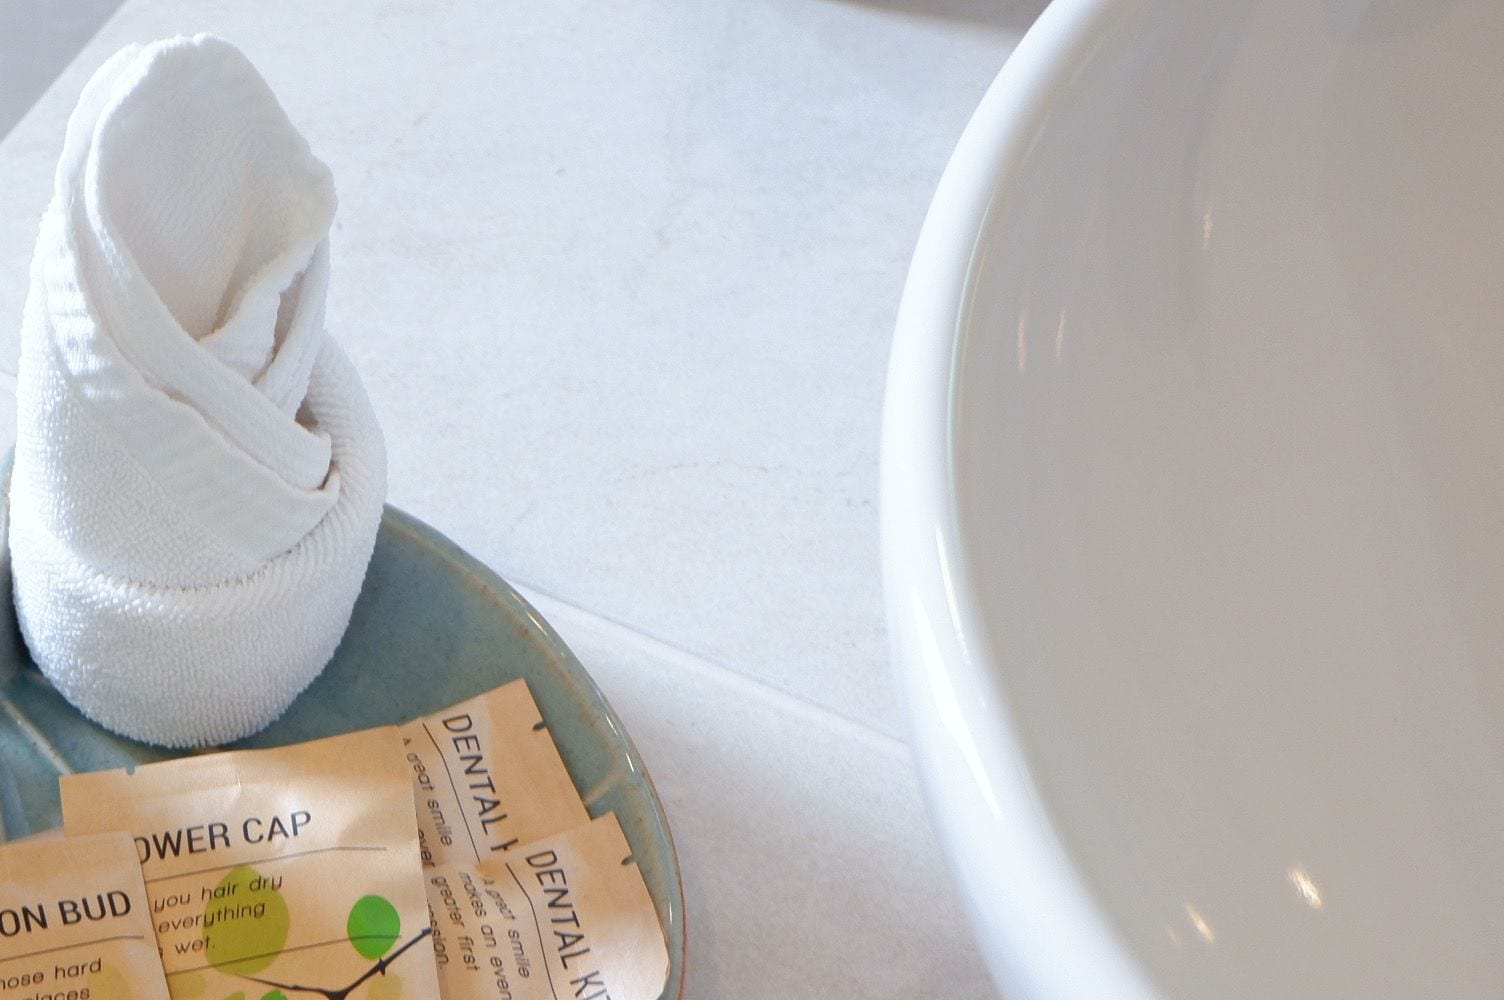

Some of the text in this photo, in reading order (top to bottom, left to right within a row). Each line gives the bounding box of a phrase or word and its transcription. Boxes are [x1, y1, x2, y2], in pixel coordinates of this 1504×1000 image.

[443, 714, 508, 835] DENTAL
[242, 810, 312, 844] CAP
[427, 799, 453, 847] smile
[58, 890, 132, 925] BUD
[154, 875, 283, 913] you hair dry
[525, 850, 590, 971] DENTAL
[158, 902, 266, 934] everything
[430, 876, 479, 972] greater first
[480, 923, 498, 949] an
[54, 957, 102, 980] hard
[507, 928, 531, 980] smile
